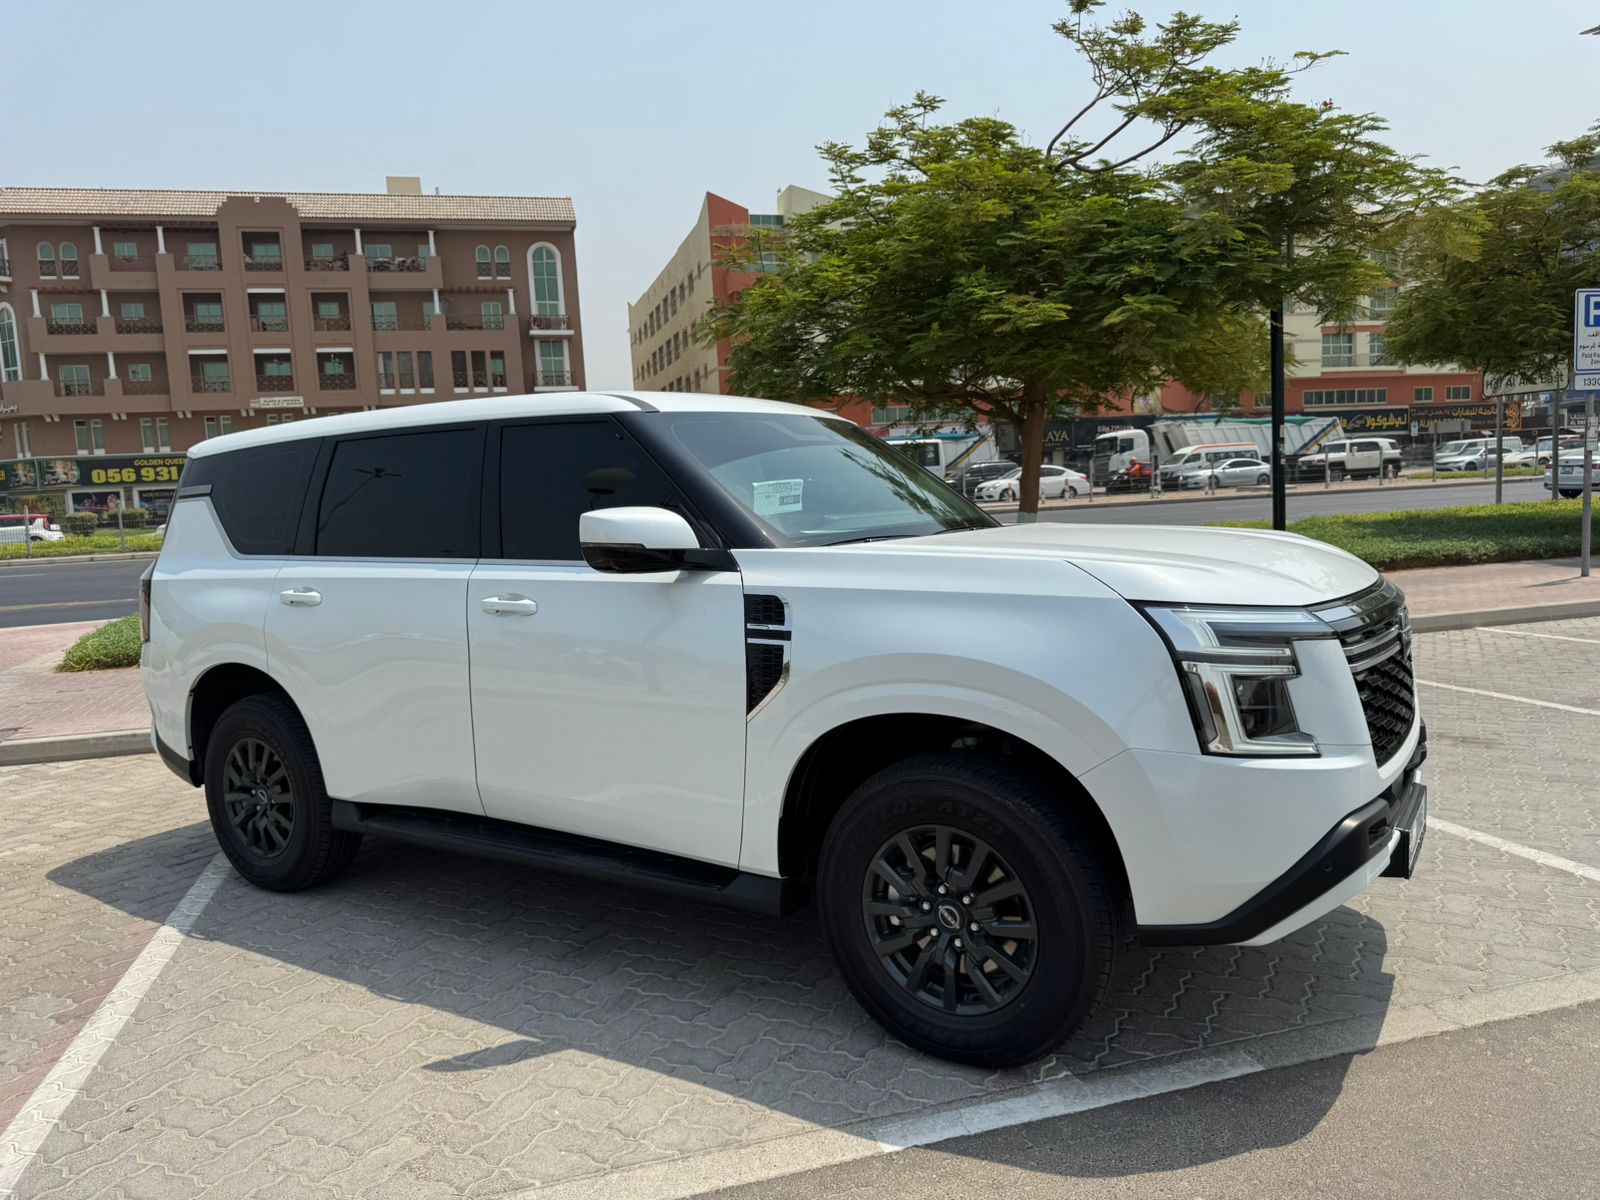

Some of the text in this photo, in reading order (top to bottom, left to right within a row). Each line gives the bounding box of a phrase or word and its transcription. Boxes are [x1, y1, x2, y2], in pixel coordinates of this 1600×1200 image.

[1540, 371, 1564, 383] East
[91, 466, 179, 484] 056 931
